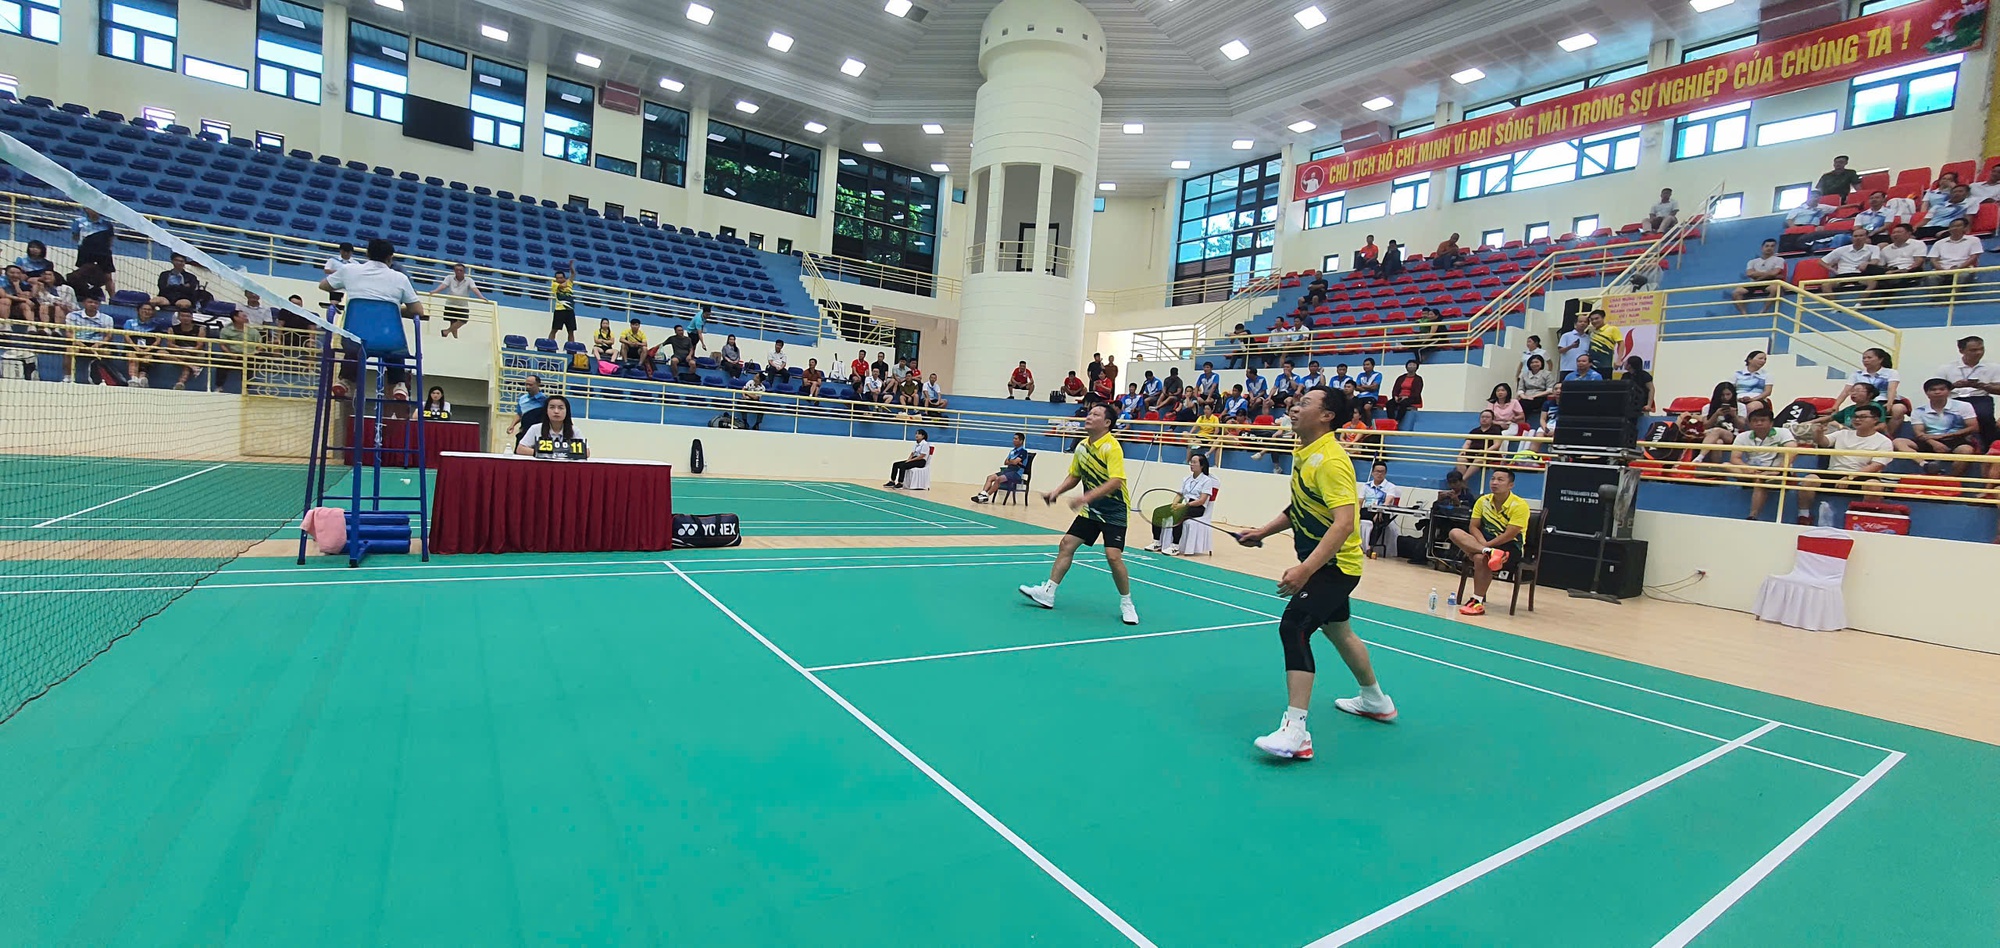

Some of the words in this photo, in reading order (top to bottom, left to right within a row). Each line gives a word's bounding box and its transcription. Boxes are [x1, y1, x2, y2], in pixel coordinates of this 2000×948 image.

[1328, 156, 1350, 184] CHỦ
[1352, 156, 1375, 182] TỊCH
[1378, 145, 1394, 173] HỒ
[1396, 140, 1417, 169] CHÍ
[1418, 137, 1450, 164] MINH
[1454, 129, 1468, 155] VĨ
[1469, 126, 1492, 154] ĐẠI
[1494, 113, 1534, 145] SỐNG
[1537, 105, 1567, 136] MÃI
[1571, 93, 1625, 128] TRONG
[1629, 83, 1656, 116] SỰ
[1657, 65, 1728, 108] NGHIỆP
[1733, 50, 1774, 90] CỦA
[1781, 34, 1859, 79] CHÚNG
[1866, 26, 1892, 58] TA
[1902, 19, 1911, 50] !
[538, 440, 553, 451] 25
[554, 441, 560, 449] 0
[571, 442, 583, 453] 11
[701, 523, 736, 536] YONEX
